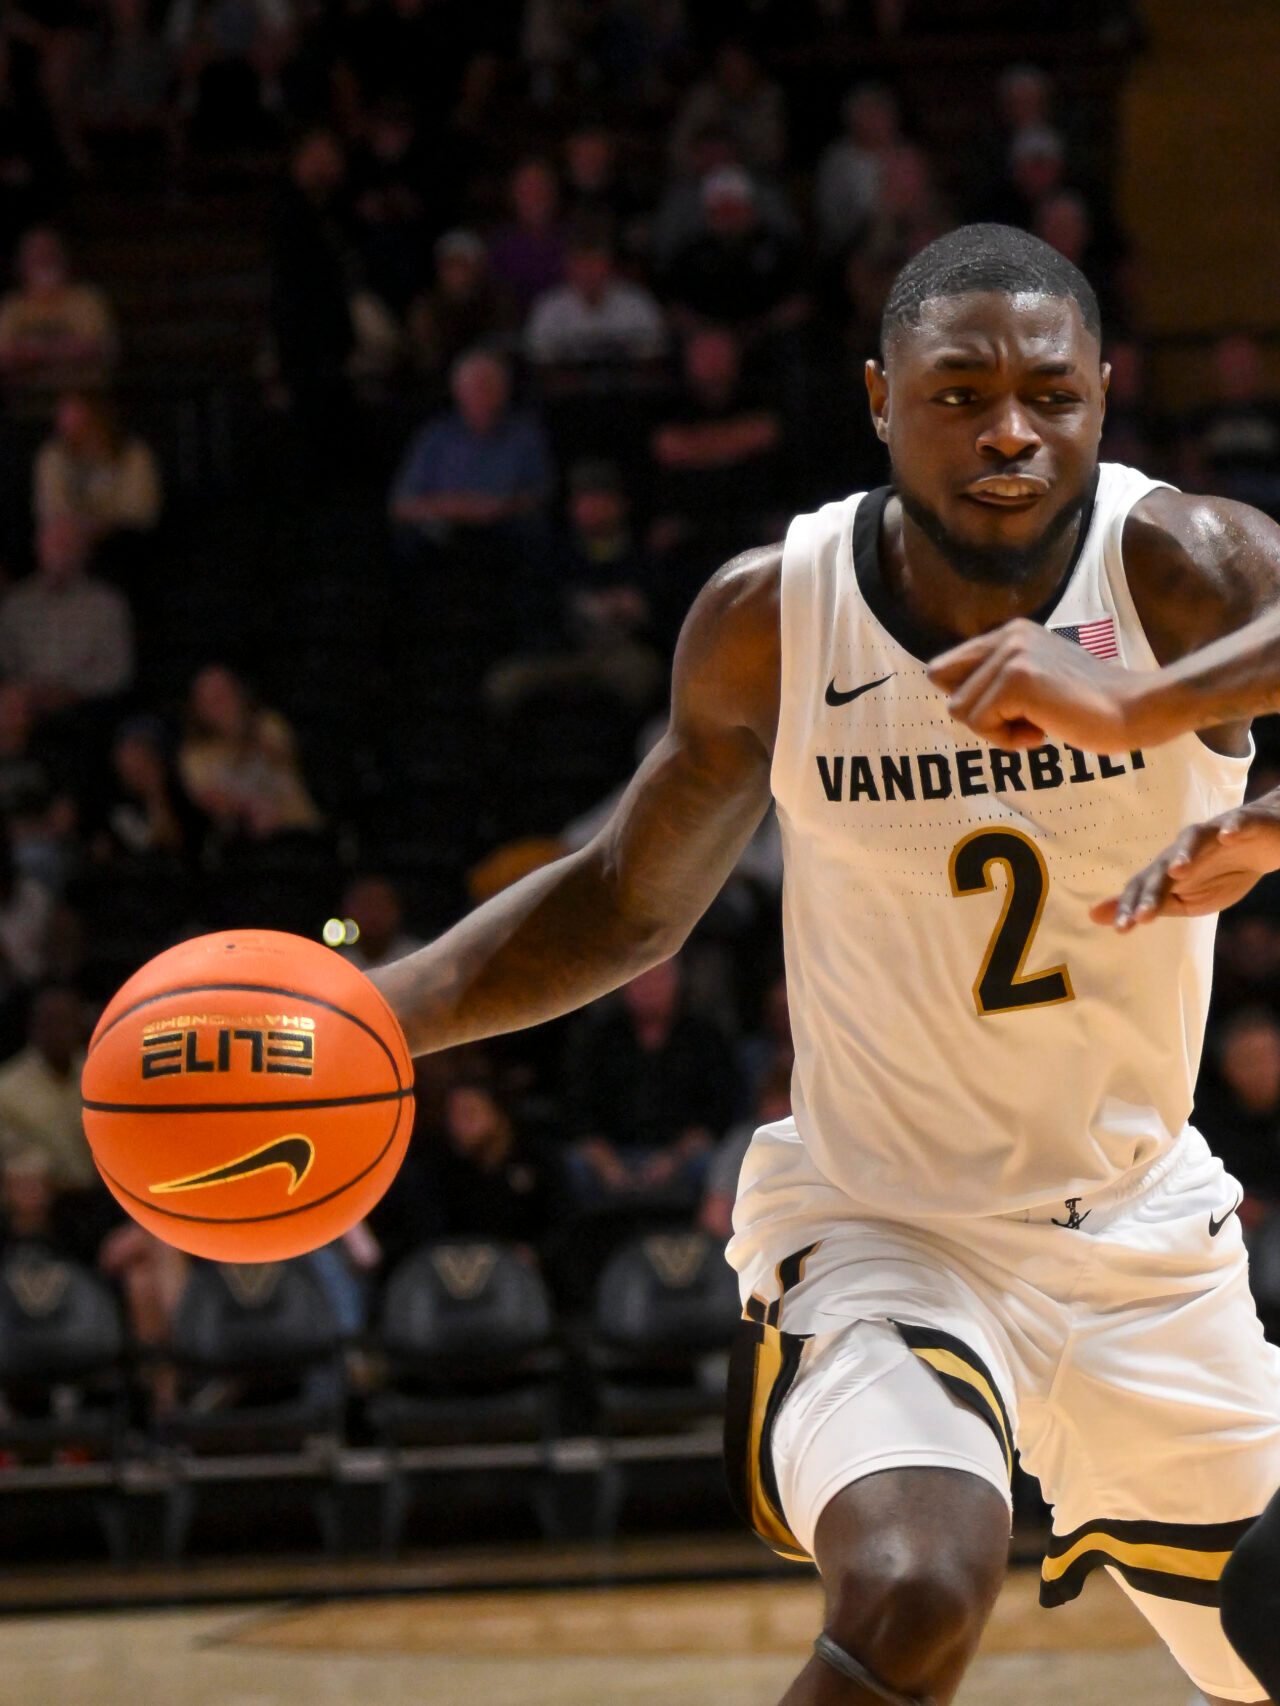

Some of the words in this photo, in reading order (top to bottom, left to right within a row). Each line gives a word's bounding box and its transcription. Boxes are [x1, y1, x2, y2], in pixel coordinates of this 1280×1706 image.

[948, 826, 1075, 1016] 2
[142, 1014, 315, 1034] CHAONSHIP
[141, 1028, 314, 1081] ELITE
